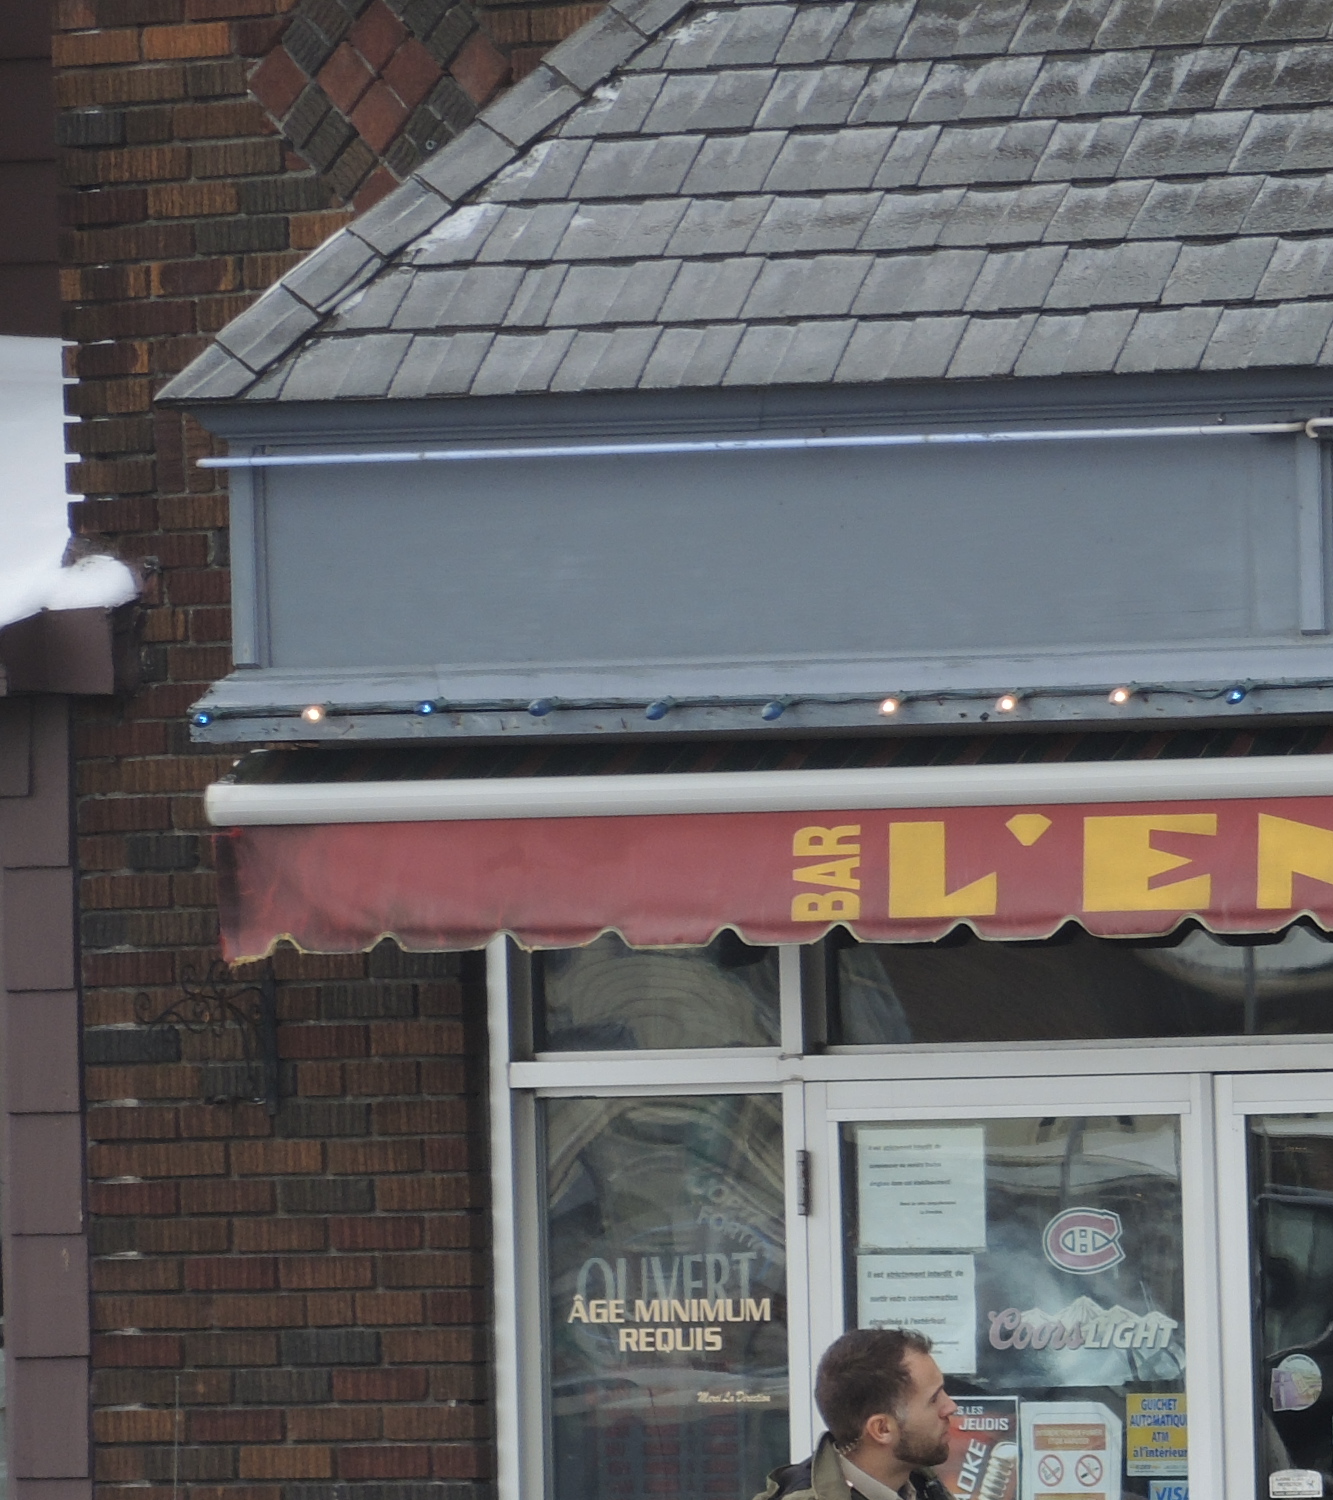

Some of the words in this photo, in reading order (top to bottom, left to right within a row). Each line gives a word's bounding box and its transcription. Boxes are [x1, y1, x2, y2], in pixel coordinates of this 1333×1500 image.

[792, 823, 862, 924] BAR
[567, 1293, 625, 1324] ÂGE
[634, 1298, 772, 1323] MINIMUM
[619, 1327, 723, 1353] REQUIS
[988, 1307, 1085, 1351] Coors
[1081, 1320, 1179, 1350] LIGHT
[1140, 1398, 1178, 1411] GUICHET
[958, 1417, 1010, 1431] JEUDIS
[1151, 1431, 1170, 1443] ATM
